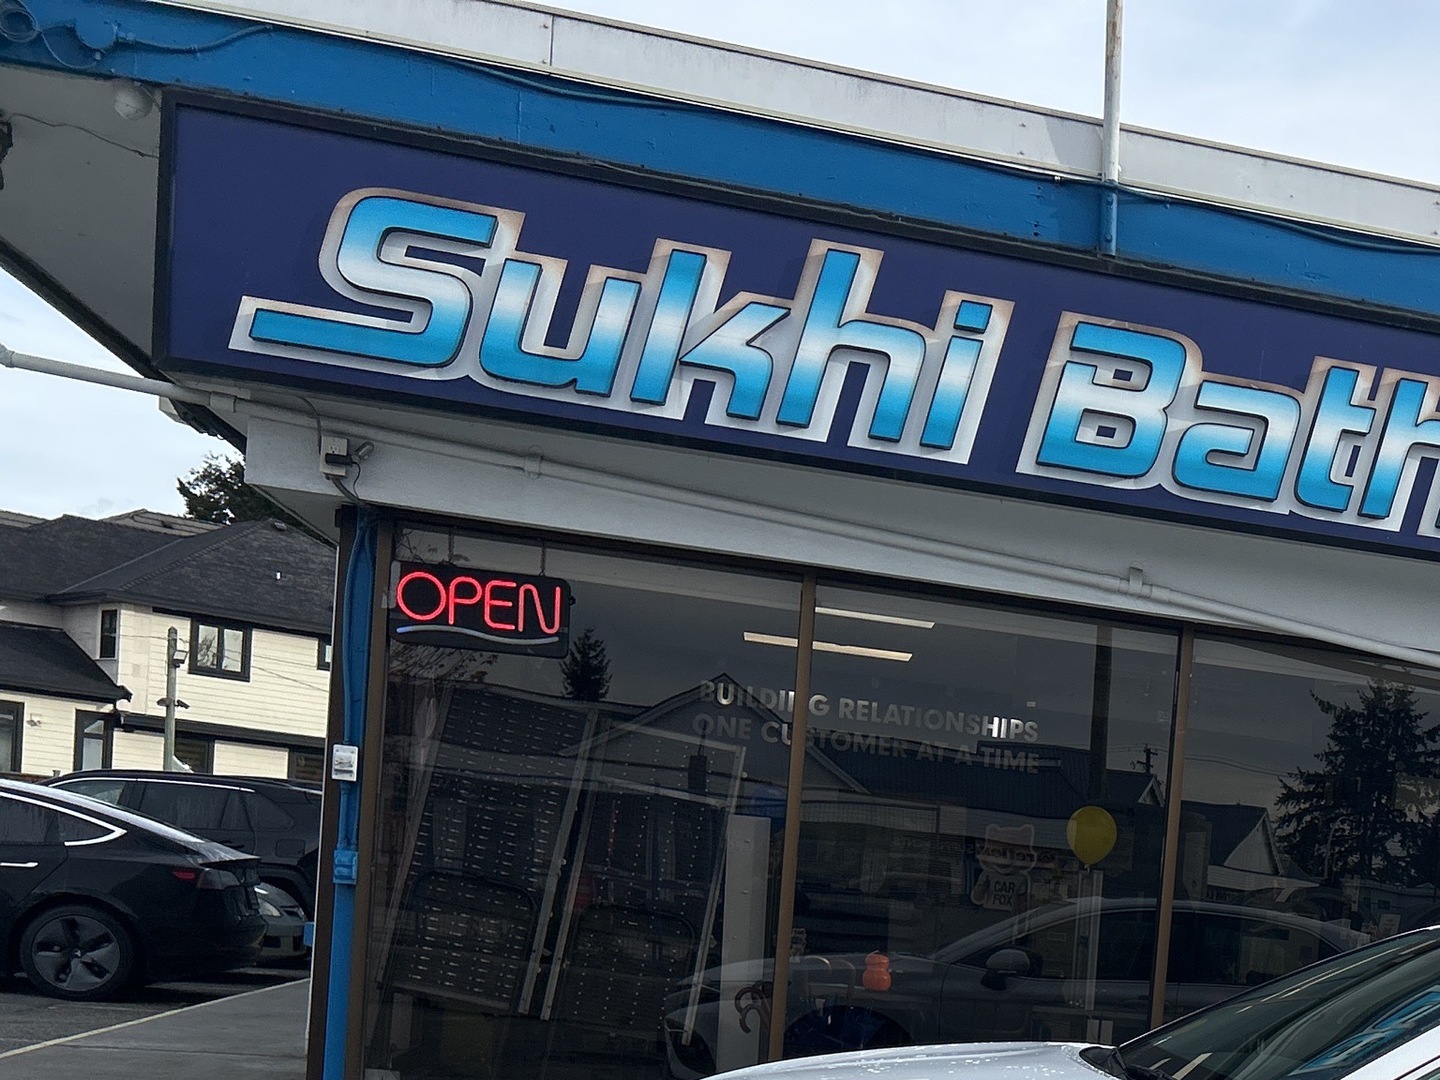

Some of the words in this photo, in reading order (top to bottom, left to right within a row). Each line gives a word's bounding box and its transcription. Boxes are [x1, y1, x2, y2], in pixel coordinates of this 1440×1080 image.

[230, 187, 1013, 463] Sukhi
[395, 571, 562, 635] OPEN
[693, 713, 751, 740] ONE
[838, 697, 1039, 742] RELATIONSHIPS
[992, 893, 1013, 907] FOX
[994, 880, 1015, 894] CAR
